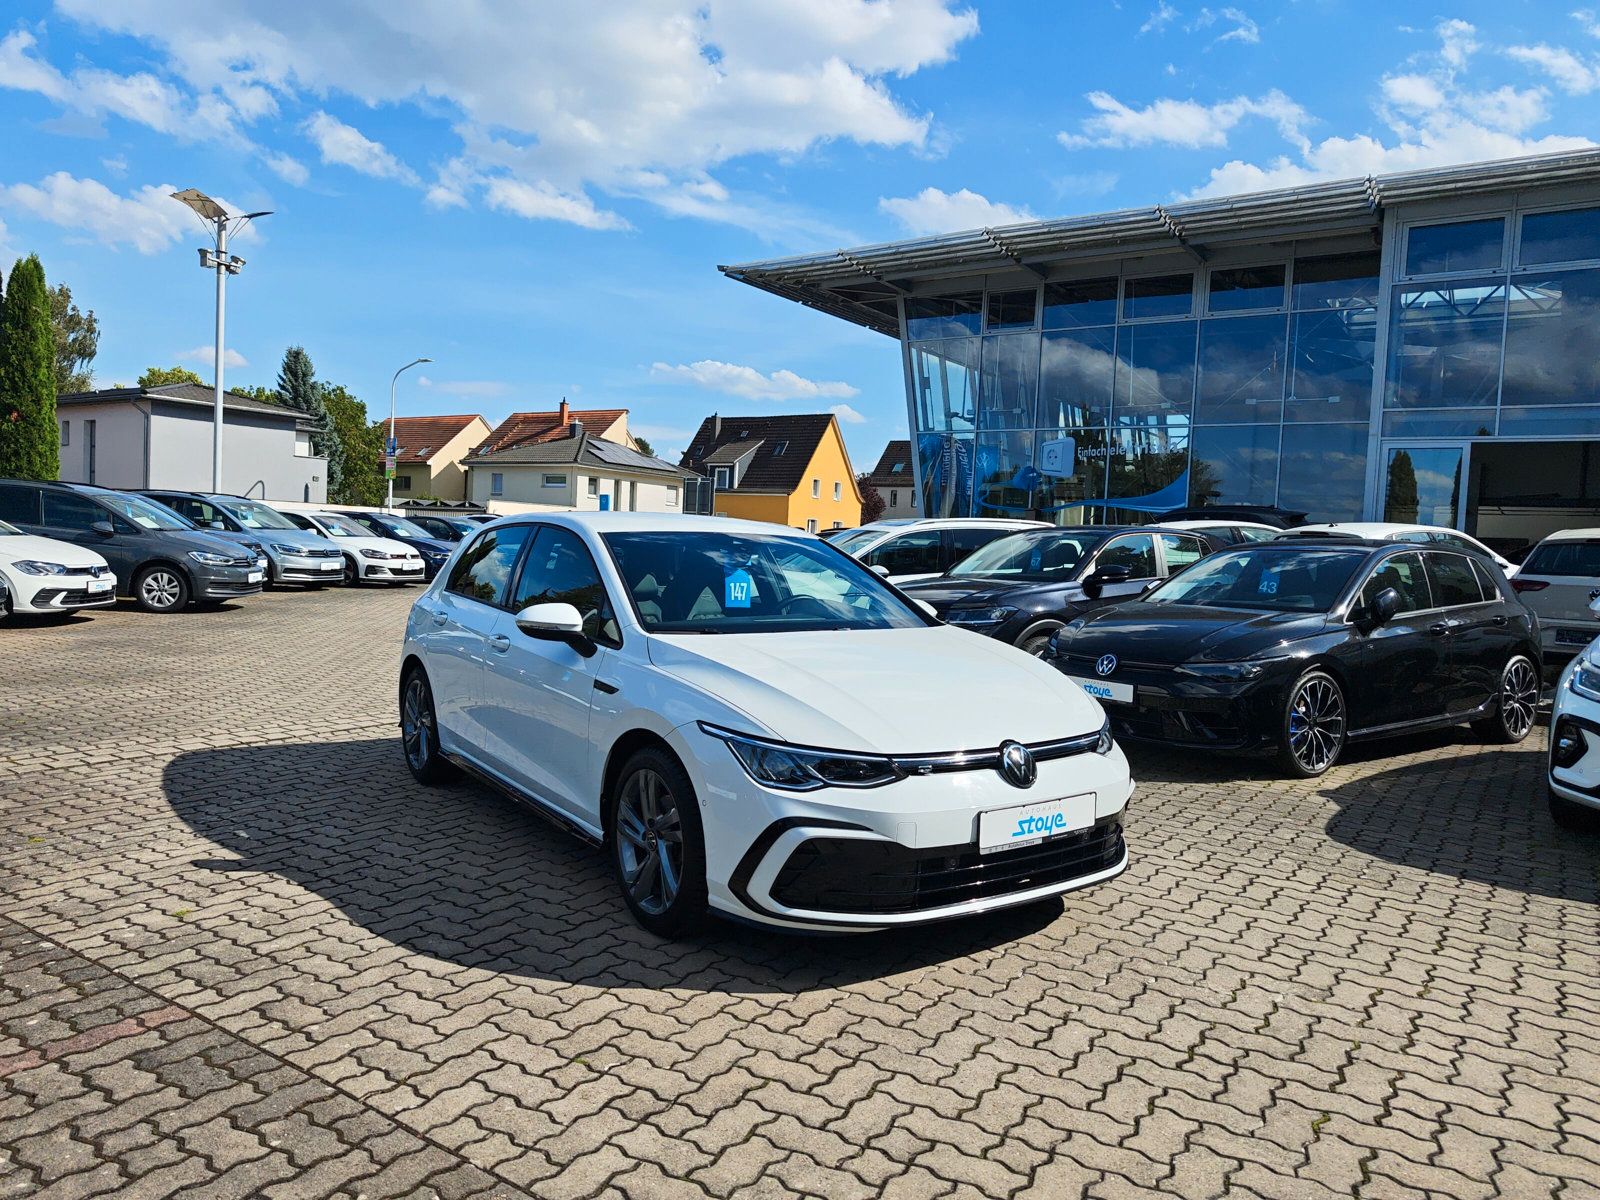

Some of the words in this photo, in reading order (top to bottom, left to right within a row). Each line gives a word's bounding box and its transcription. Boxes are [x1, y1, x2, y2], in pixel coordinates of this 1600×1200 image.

[1077, 444, 1106, 458] Einfach
[729, 582, 748, 601] 147
[1259, 581, 1277, 594] 43
[1019, 803, 1063, 816] AUTOHAUS
